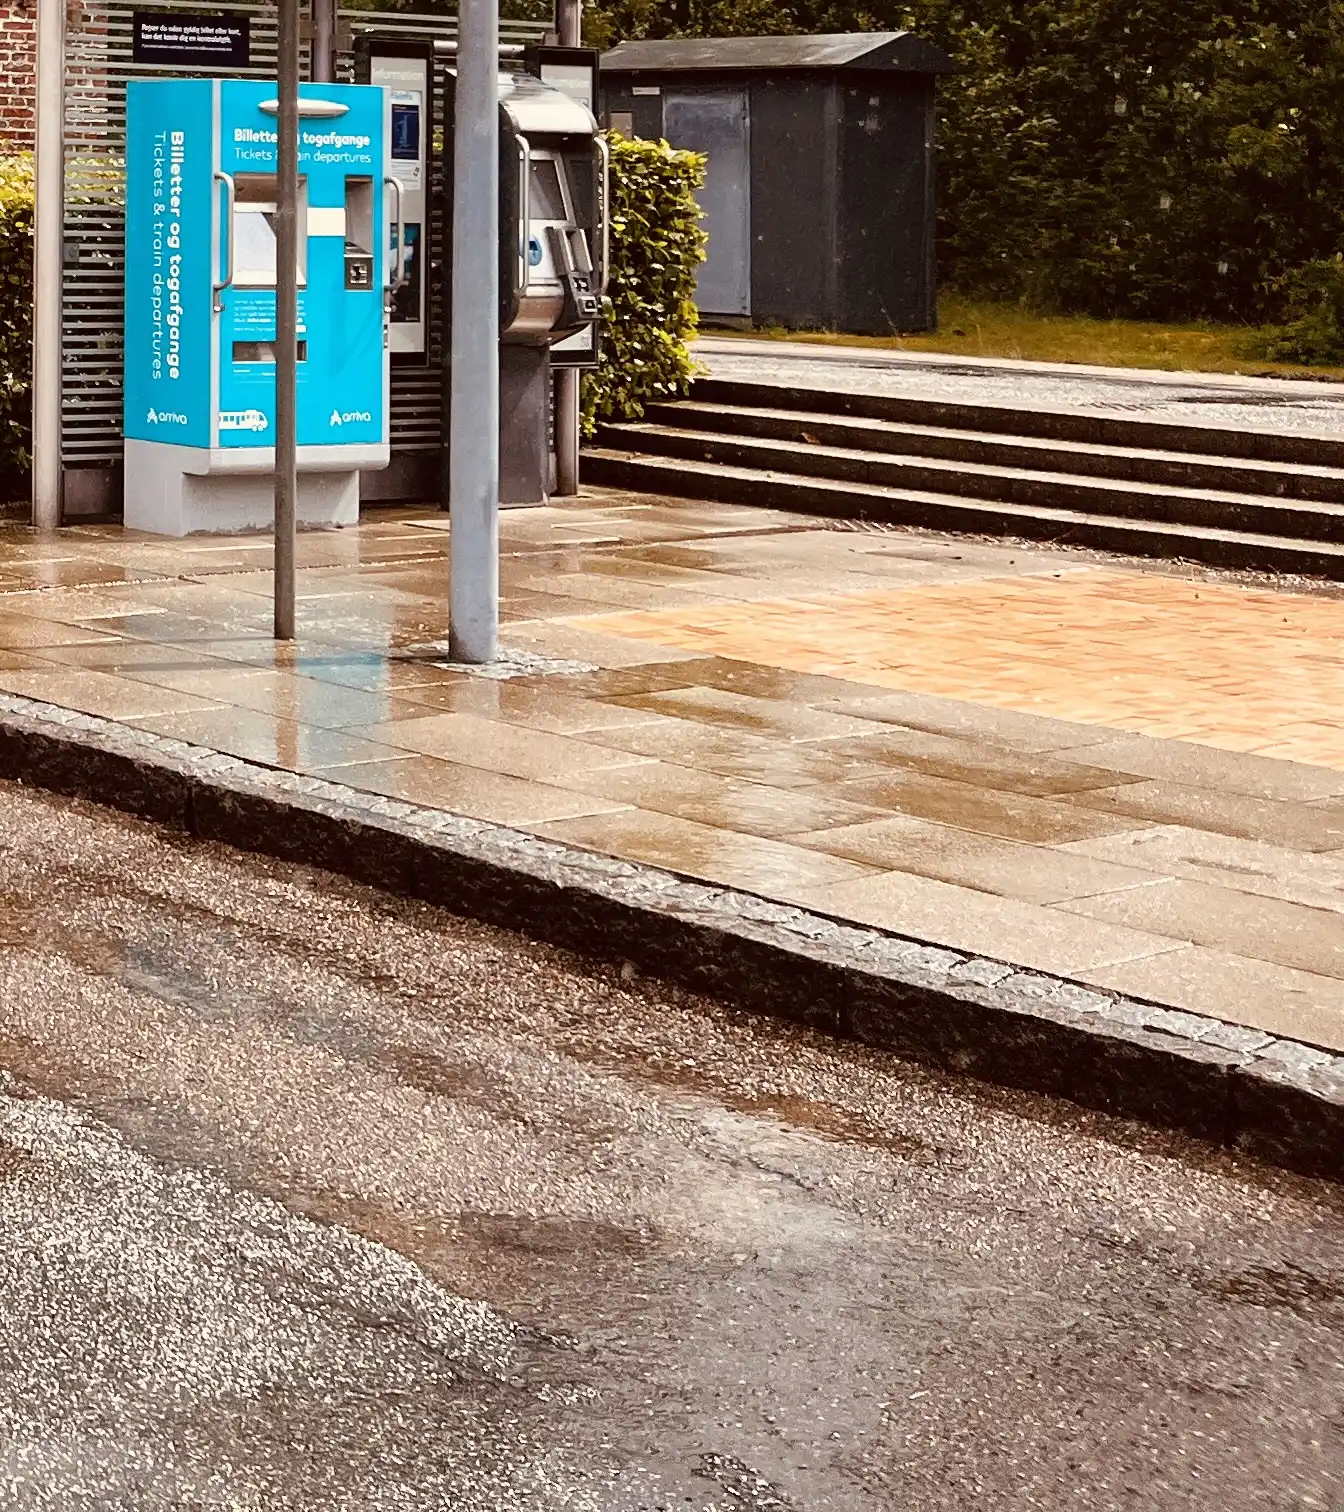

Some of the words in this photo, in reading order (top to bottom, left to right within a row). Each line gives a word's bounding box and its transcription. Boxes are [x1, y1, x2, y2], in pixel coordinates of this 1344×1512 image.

[234, 128, 278, 143] Billette
[302, 131, 371, 148] togafgange
[153, 130, 167, 197] Tickets
[234, 147, 272, 161] Tickets
[313, 150, 372, 164] departures
[170, 131, 184, 218] Billetter
[153, 202, 166, 216] &
[153, 221, 165, 267] train
[166, 222, 181, 249] og
[150, 272, 165, 380] departures
[166, 253, 184, 380] togafgange
[158, 412, 188, 425] arriva
[342, 408, 372, 422] arriva
